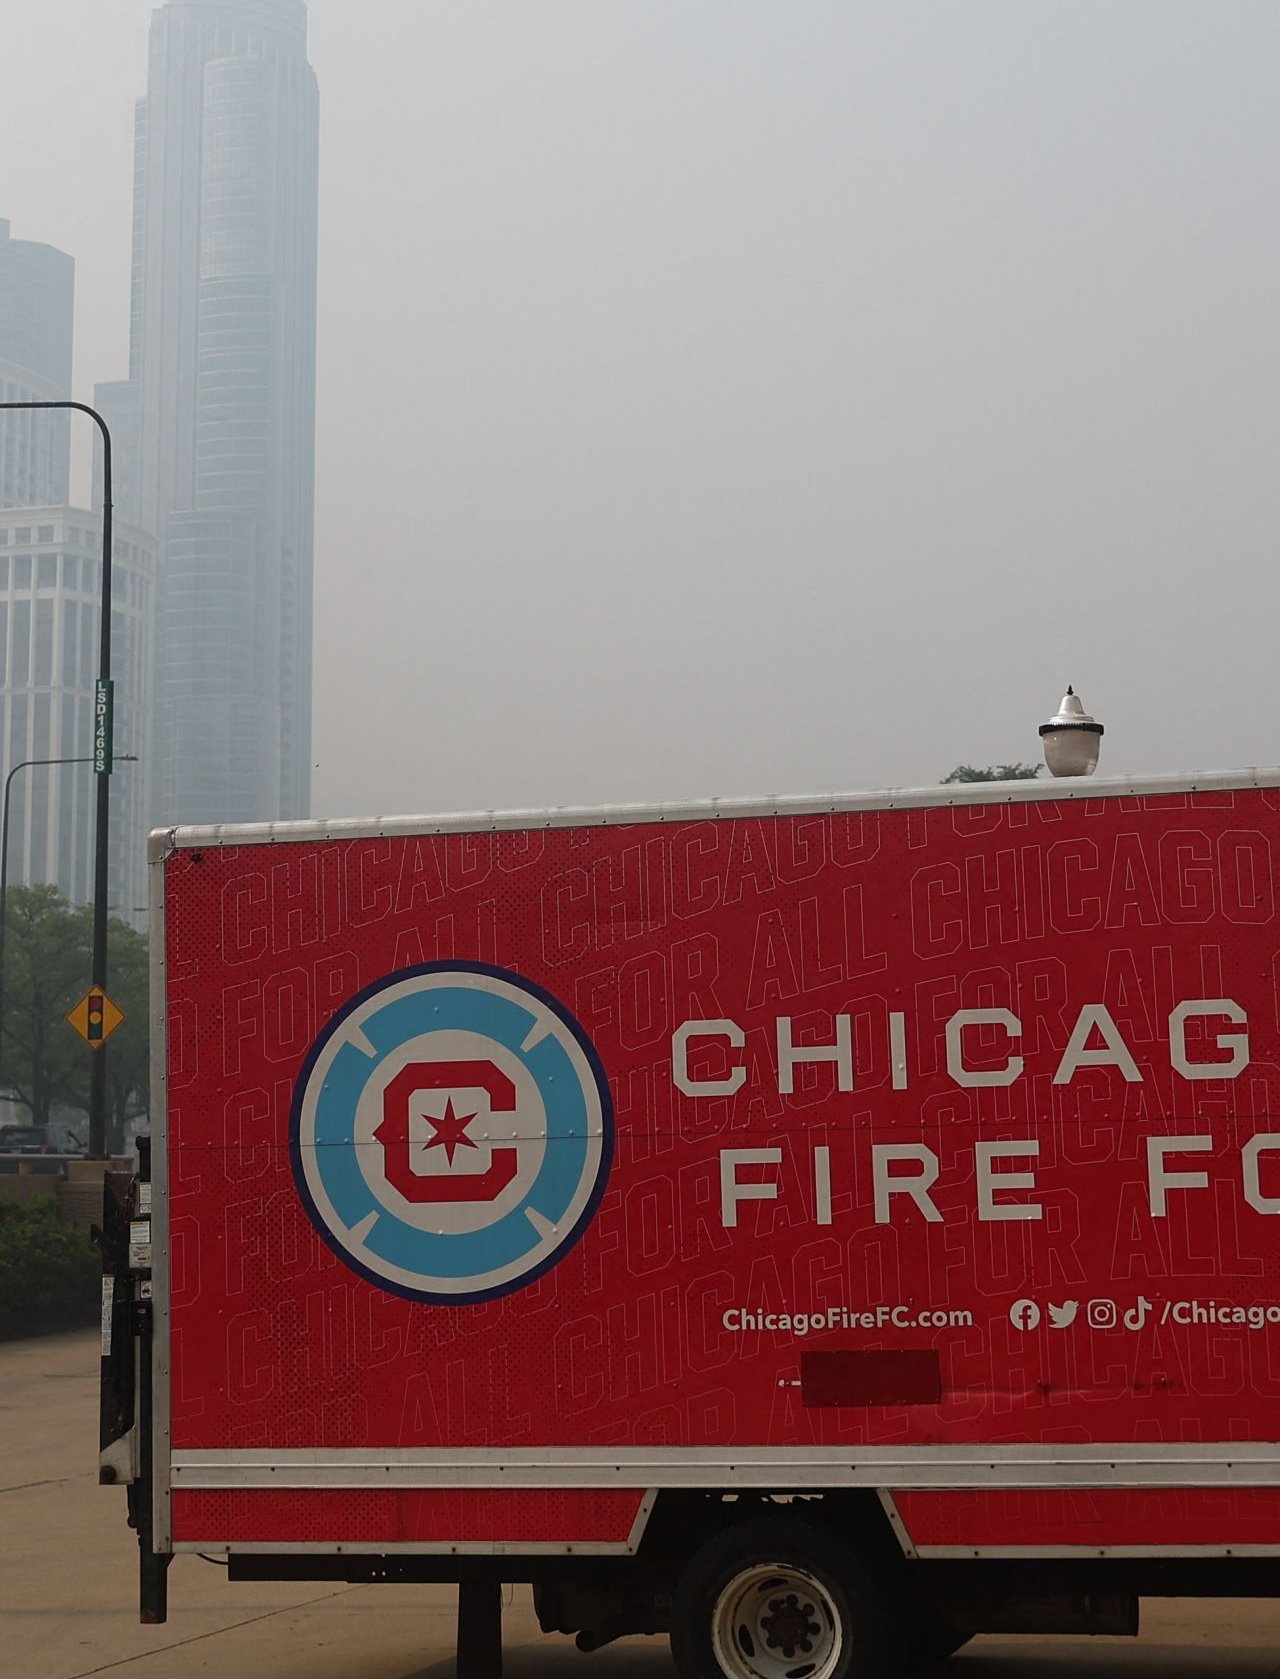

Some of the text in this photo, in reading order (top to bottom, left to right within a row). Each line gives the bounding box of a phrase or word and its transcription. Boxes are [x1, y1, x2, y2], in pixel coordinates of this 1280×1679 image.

[95, 681, 107, 772] LSD1469S
[746, 883, 888, 1012] ALL
[911, 829, 1276, 961] CHICAGO
[720, 1139, 1043, 1227] FIRE
[1110, 1178, 1265, 1280] ALL
[722, 1305, 972, 1335] ChicagoFireFC.com
